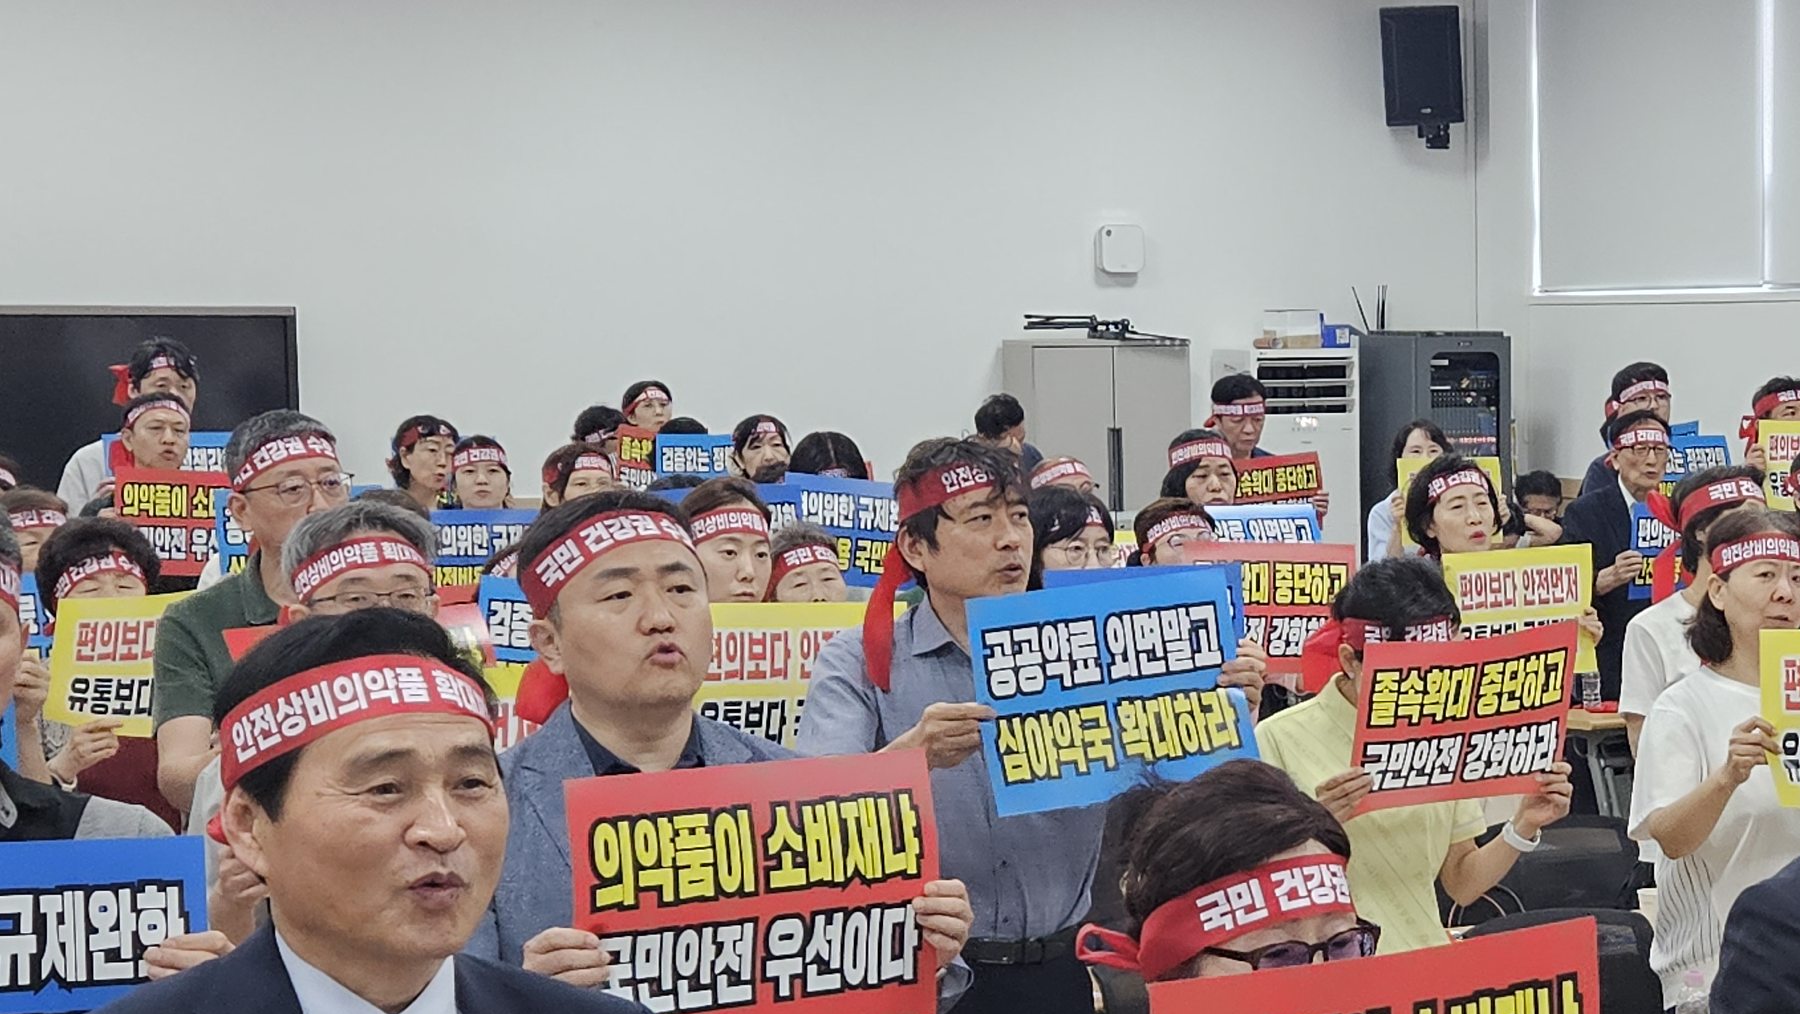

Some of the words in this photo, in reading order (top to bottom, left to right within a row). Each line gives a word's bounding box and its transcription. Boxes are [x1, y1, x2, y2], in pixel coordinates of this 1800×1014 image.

[122, 483, 188, 518] 의약품이
[535, 539, 586, 588] 국민
[579, 514, 662, 556] 건강권
[1459, 572, 1518, 611] 편의보다
[1521, 565, 1580, 609] 안전먼저
[1107, 604, 1226, 684] 외면말고
[231, 666, 429, 765] 안전상비의약품
[1368, 665, 1476, 729] 졸속확대
[1476, 648, 1569, 718] 중단하고
[997, 703, 1119, 786] 심야약국
[1116, 686, 1242, 764] 확대하라
[1363, 735, 1464, 792] 국민안전
[1462, 719, 1558, 784] 강화하라
[593, 808, 757, 908] 의약품이
[767, 793, 920, 889] 소비재냐
[1196, 879, 1269, 932] 국민
[1270, 861, 1354, 909] 건강권
[764, 904, 920, 998] 우선이다
